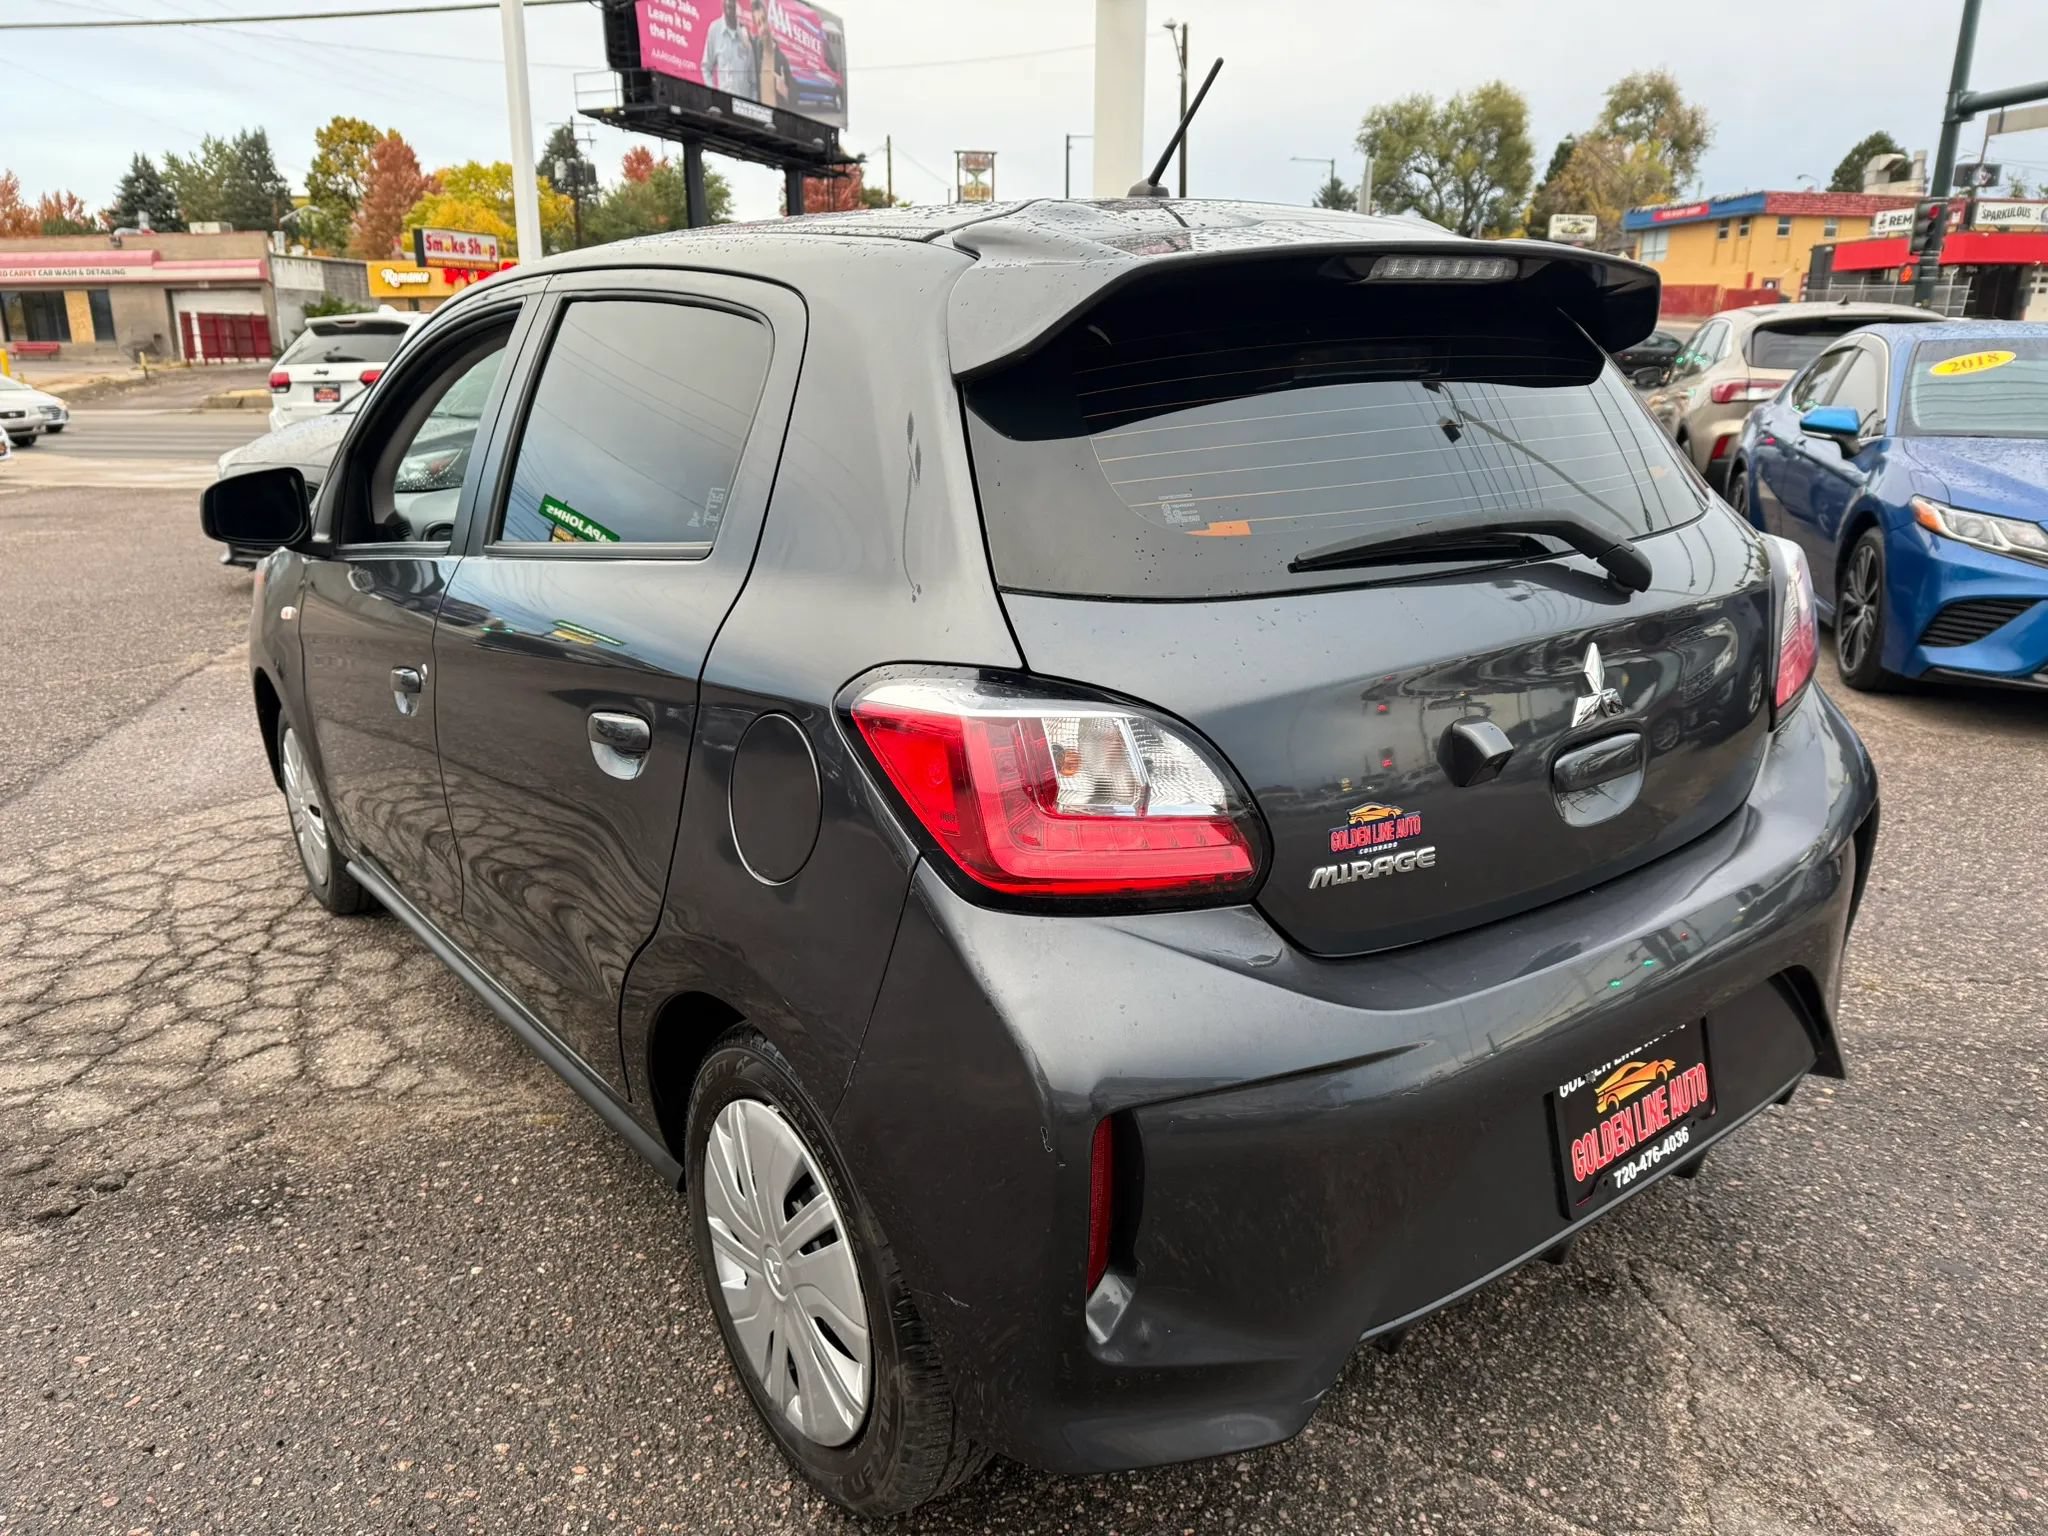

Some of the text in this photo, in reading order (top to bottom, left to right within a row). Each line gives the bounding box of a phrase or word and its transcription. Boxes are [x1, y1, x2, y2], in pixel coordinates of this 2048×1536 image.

[647, 4, 692, 32] Leave it to
[649, 22, 689, 48] the Pros.
[1981, 206, 2031, 220] SPARKULOUS
[425, 234, 496, 260] Smoke Shop
[9, 269, 36, 277] CARPET
[54, 268, 77, 276] WASH
[86, 267, 126, 275] DETAILING
[380, 268, 431, 288] Romance
[1949, 353, 2000, 373] 2018
[1331, 815, 1421, 852] GOLDEN LINE AUTO
[1359, 841, 1398, 855] COLORADO
[1308, 846, 1436, 889] MIRAGE
[1571, 1062, 1709, 1182] GOLDEN LINE AUTO
[1613, 1126, 1690, 1188] 720-476-4036
